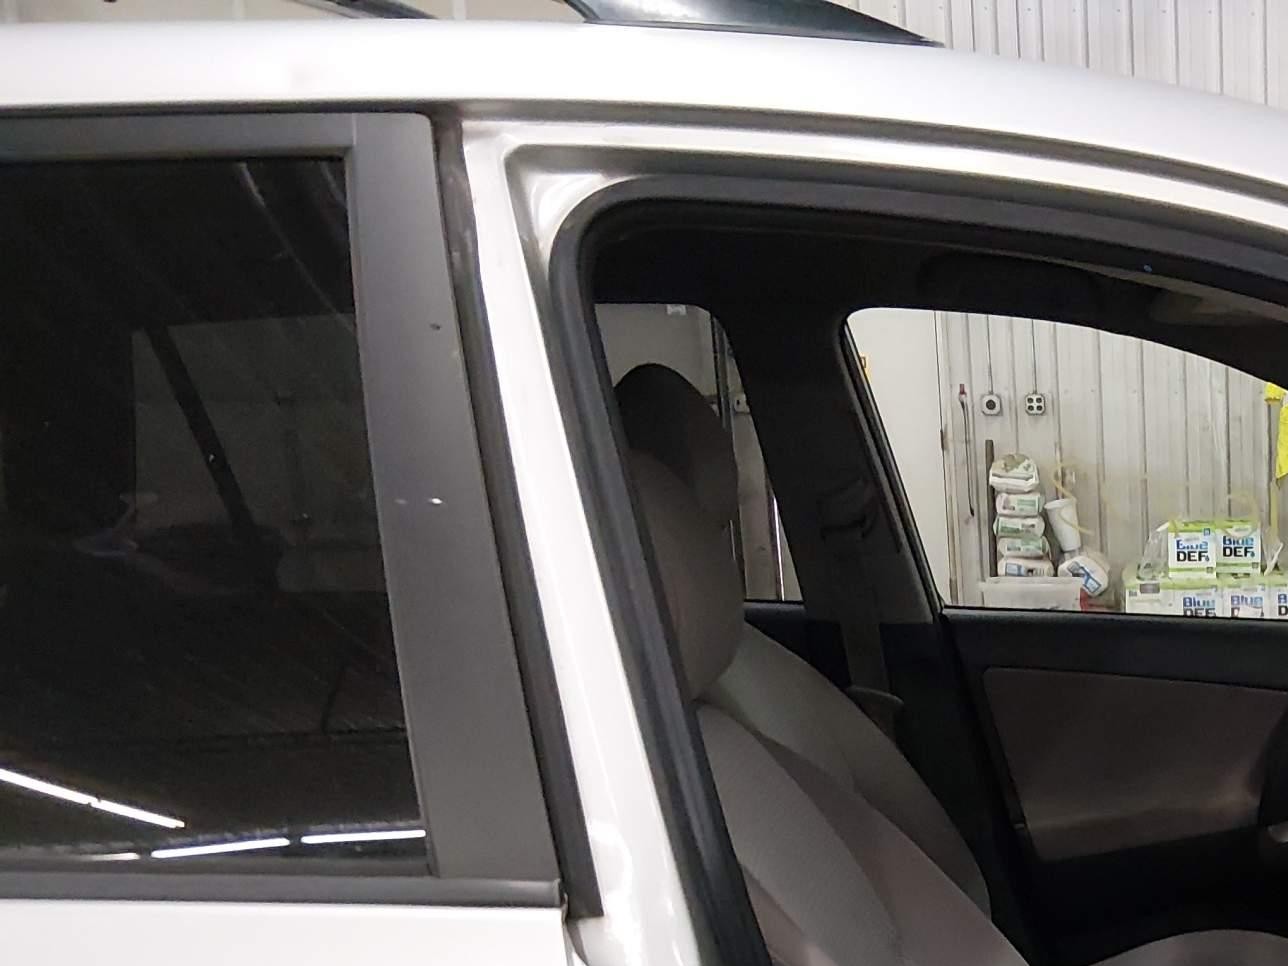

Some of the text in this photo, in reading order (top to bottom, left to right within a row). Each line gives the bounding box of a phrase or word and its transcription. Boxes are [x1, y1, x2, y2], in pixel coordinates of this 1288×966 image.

[1176, 551, 1208, 562] DEF
[1223, 547, 1252, 557] DEF
[1183, 597, 1216, 607] Blue
[1231, 595, 1264, 606] Blue
